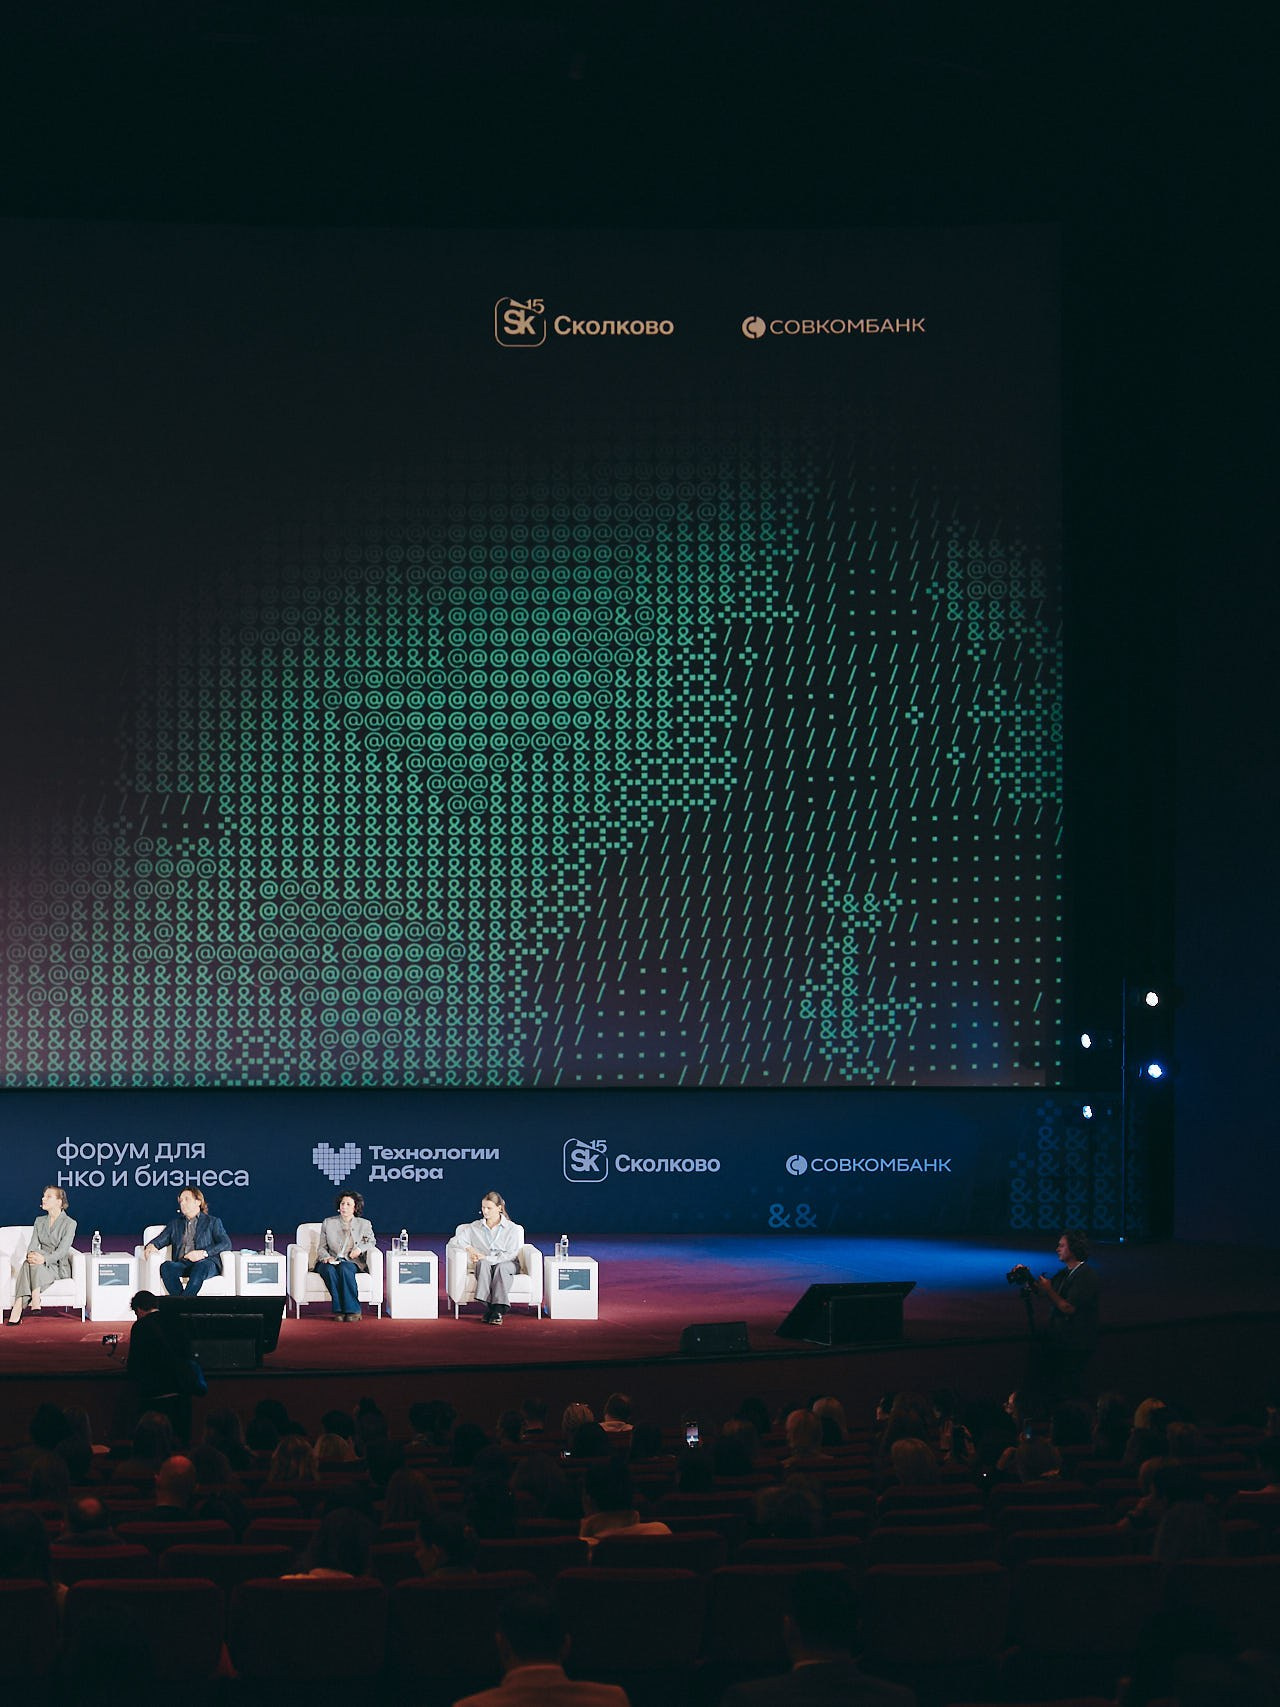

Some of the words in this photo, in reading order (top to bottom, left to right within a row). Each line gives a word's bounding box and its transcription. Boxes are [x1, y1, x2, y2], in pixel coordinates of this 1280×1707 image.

[555, 316, 674, 335] Сколково
[770, 319, 924, 334] СОВКОМБАНК
[56, 1136, 149, 1166] форум
[154, 1142, 206, 1163] для
[369, 1146, 499, 1160] Технологии
[616, 1154, 720, 1172] Сколково
[811, 1159, 951, 1171] СОВКОМБАНК
[58, 1171, 105, 1187] нко
[113, 1171, 127, 1186] и
[135, 1164, 249, 1186] бизнеса
[369, 1165, 443, 1182] Добра
